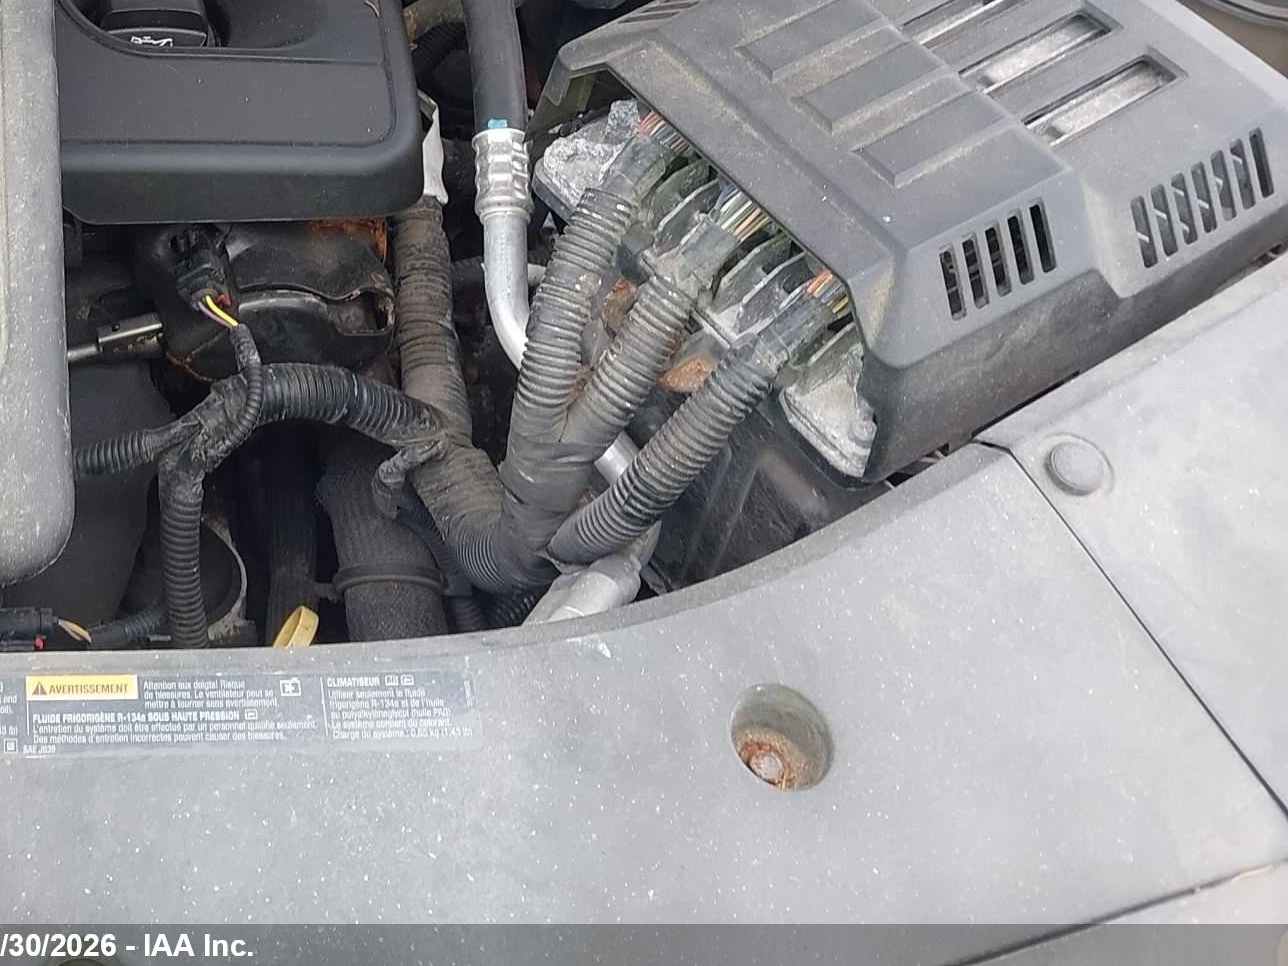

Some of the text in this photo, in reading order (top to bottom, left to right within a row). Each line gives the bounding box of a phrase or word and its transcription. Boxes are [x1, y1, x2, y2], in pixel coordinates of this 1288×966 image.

[144, 680, 177, 690] Attention
[220, 680, 245, 690] Risque
[327, 676, 380, 687] CLIMATISEUR
[49, 683, 129, 694] AVERTISSEMENT
[33, 713, 61, 724] FLUIDE
[117, 712, 146, 723] R-134a
[148, 712, 170, 722] SOUS
[171, 712, 198, 722] HAUTE
[200, 711, 240, 722] PRESSION
